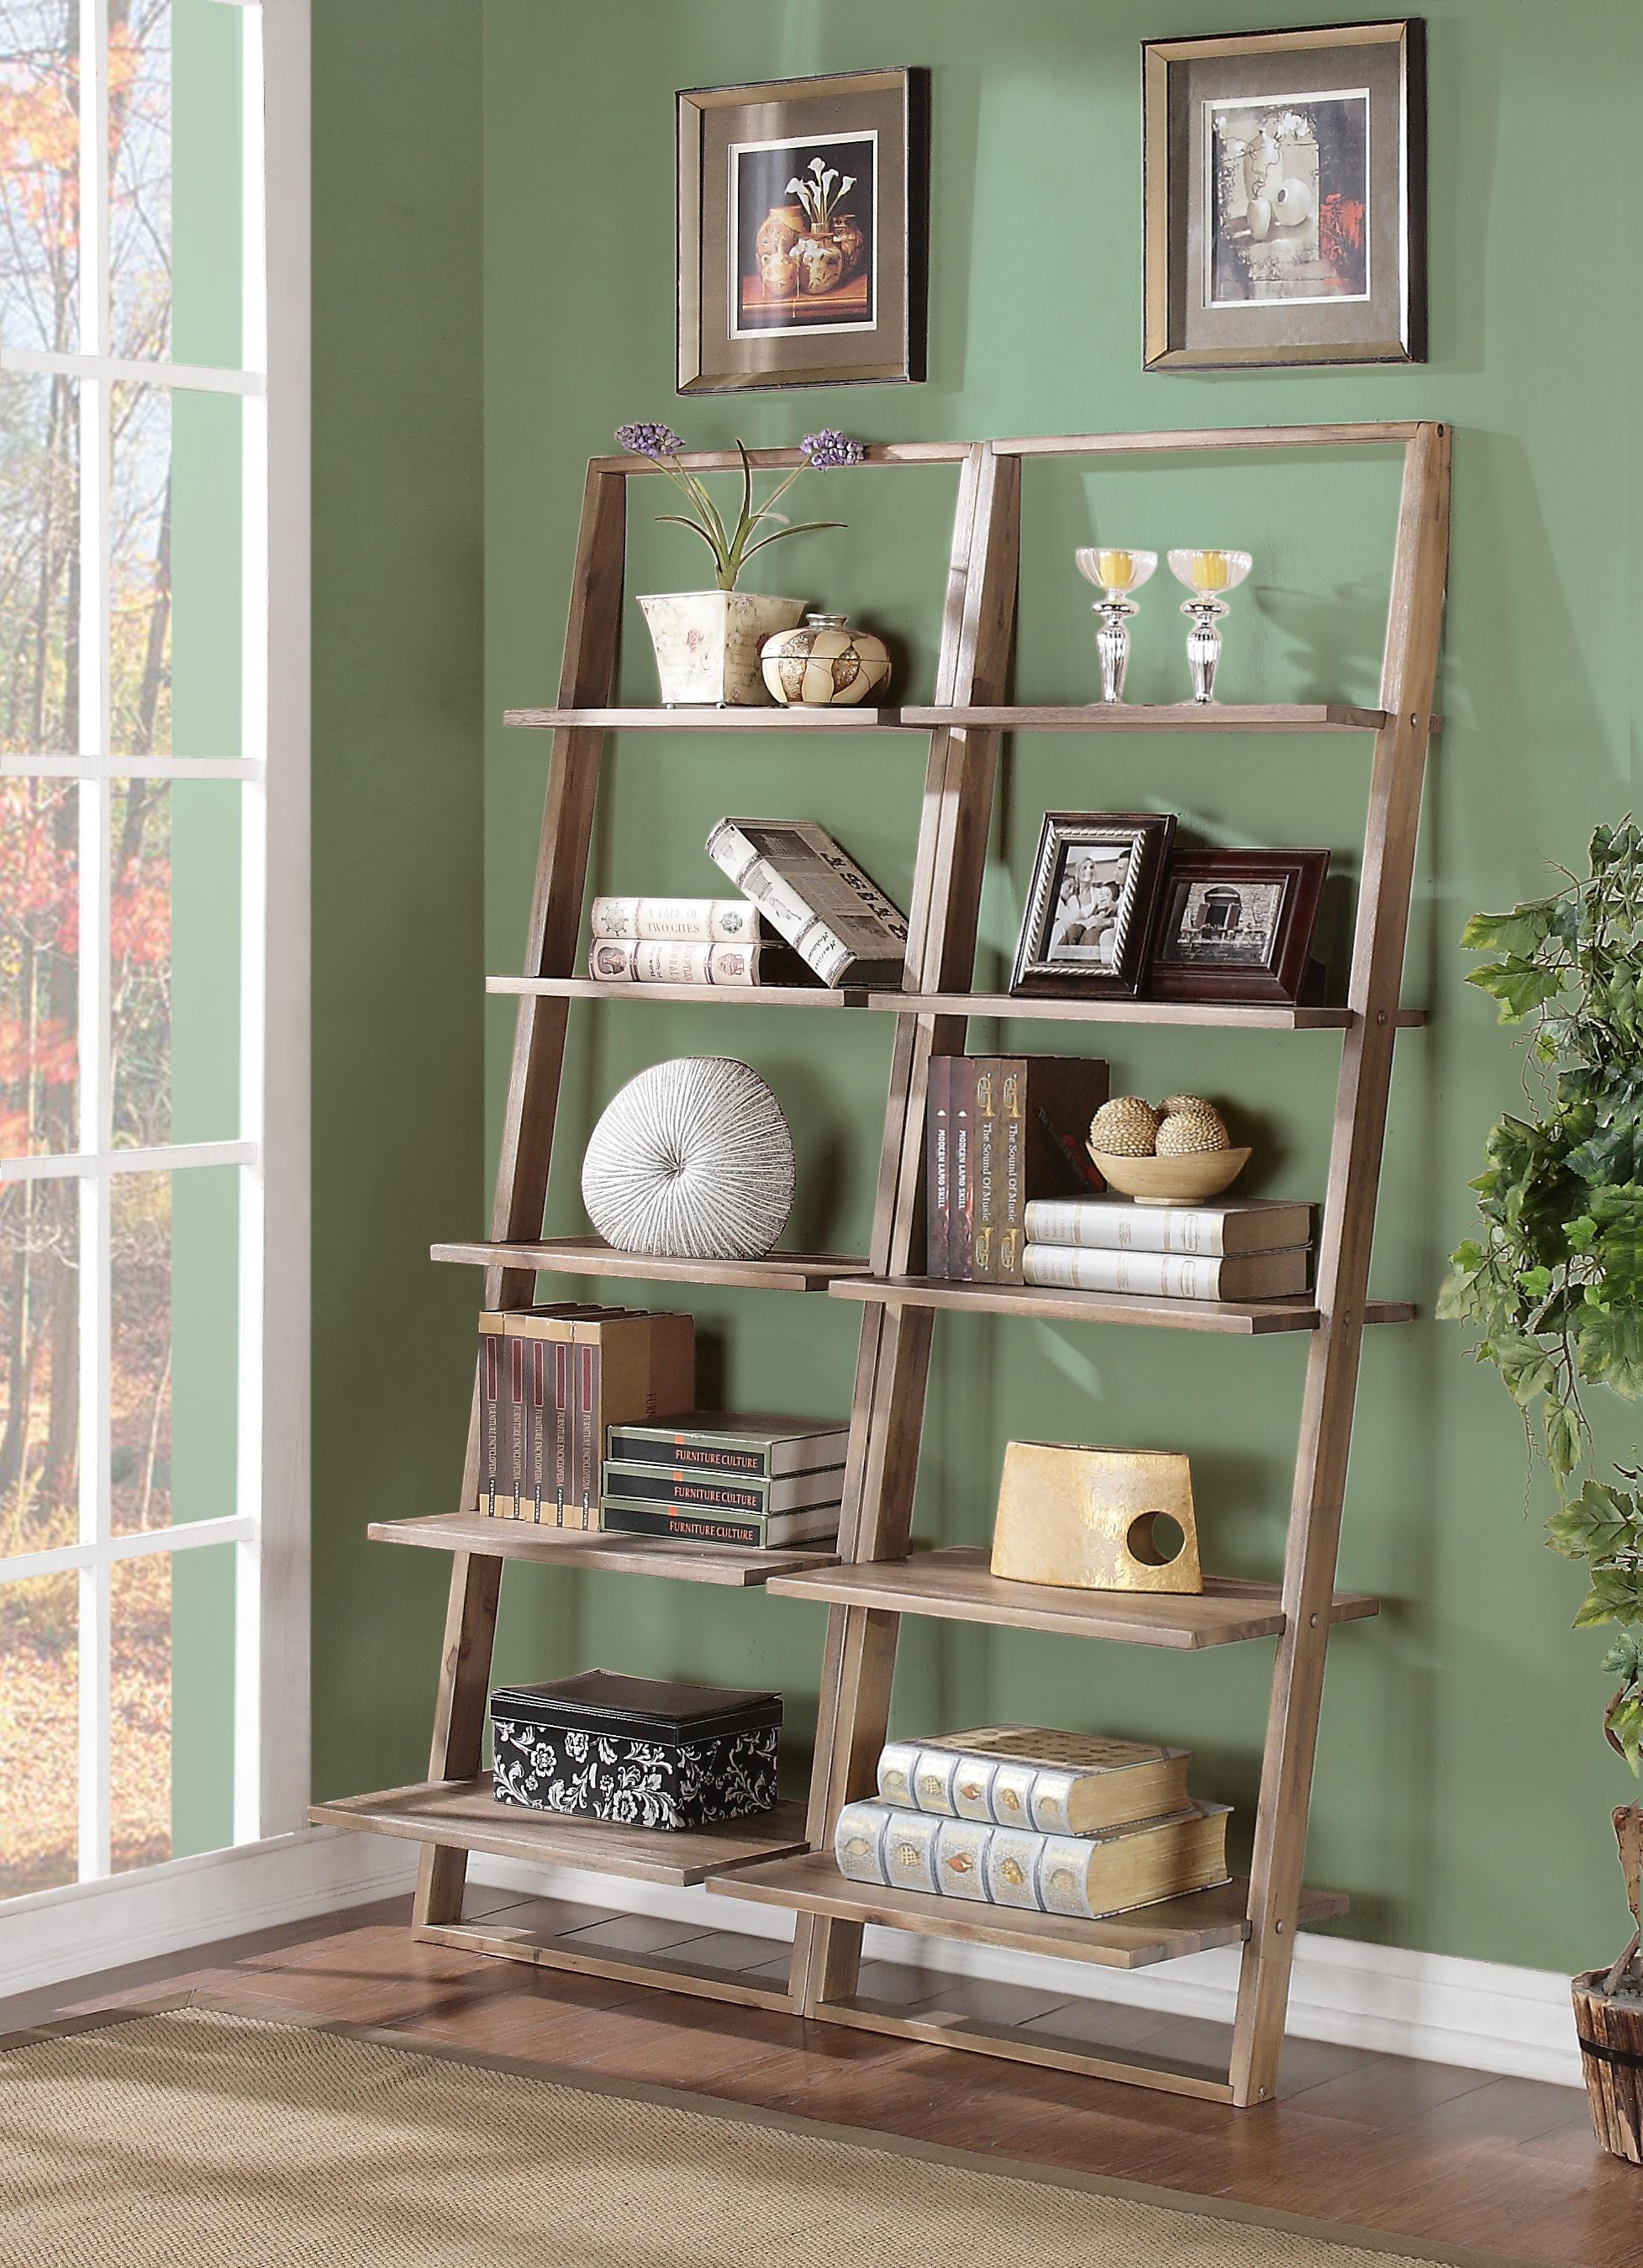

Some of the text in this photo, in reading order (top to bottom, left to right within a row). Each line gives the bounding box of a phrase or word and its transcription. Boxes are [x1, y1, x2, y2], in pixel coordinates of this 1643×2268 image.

[646, 922, 669, 932] TWO
[958, 1130, 966, 1163] MODERN
[982, 1122, 992, 1221] The Sound Of Music
[1008, 1123, 1018, 1222] The Sound Of Music
[675, 1449, 758, 1469] FURNITURE CULTURE
[674, 1486, 756, 1506] FURNITURE CULTURE
[670, 1521, 754, 1541] FURNITURE CULTURE
